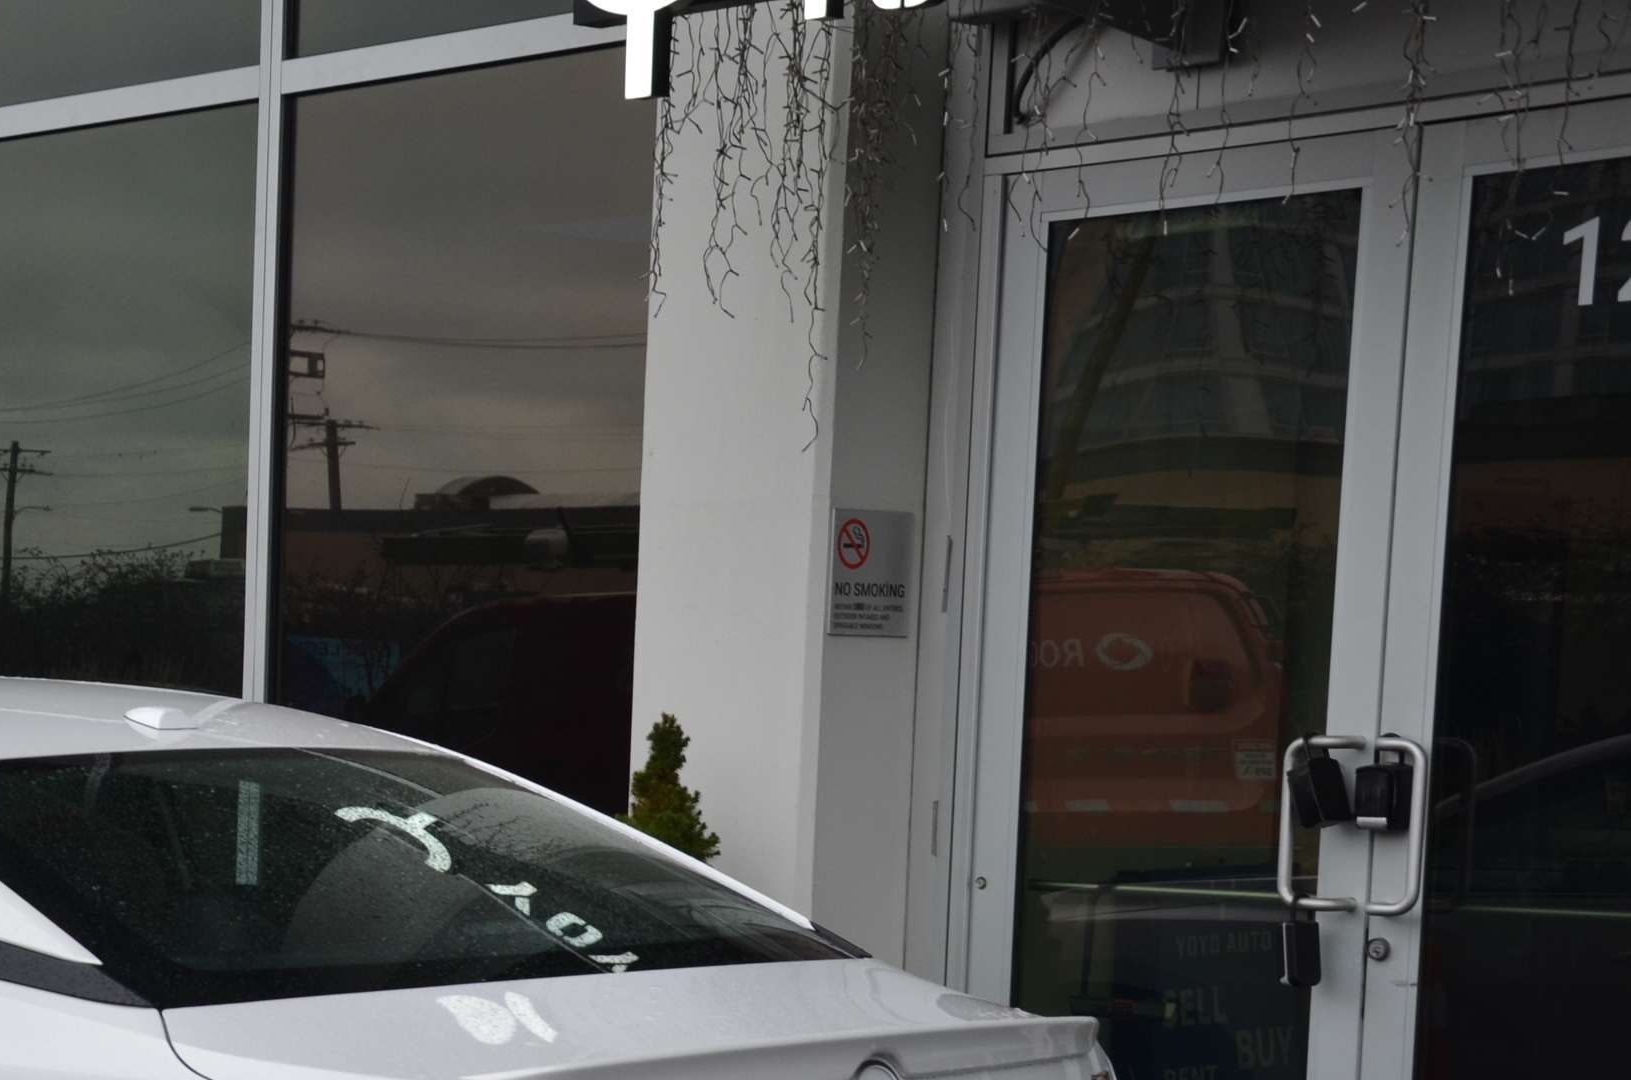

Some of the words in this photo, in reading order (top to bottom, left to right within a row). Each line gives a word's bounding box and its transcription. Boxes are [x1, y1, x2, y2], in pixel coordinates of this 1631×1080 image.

[834, 582, 851, 596] NO
[854, 582, 906, 598] SMOKING
[1226, 929, 1273, 953] AUTO
[1161, 986, 1228, 1027] SELL
[1235, 1025, 1295, 1071] BUY
